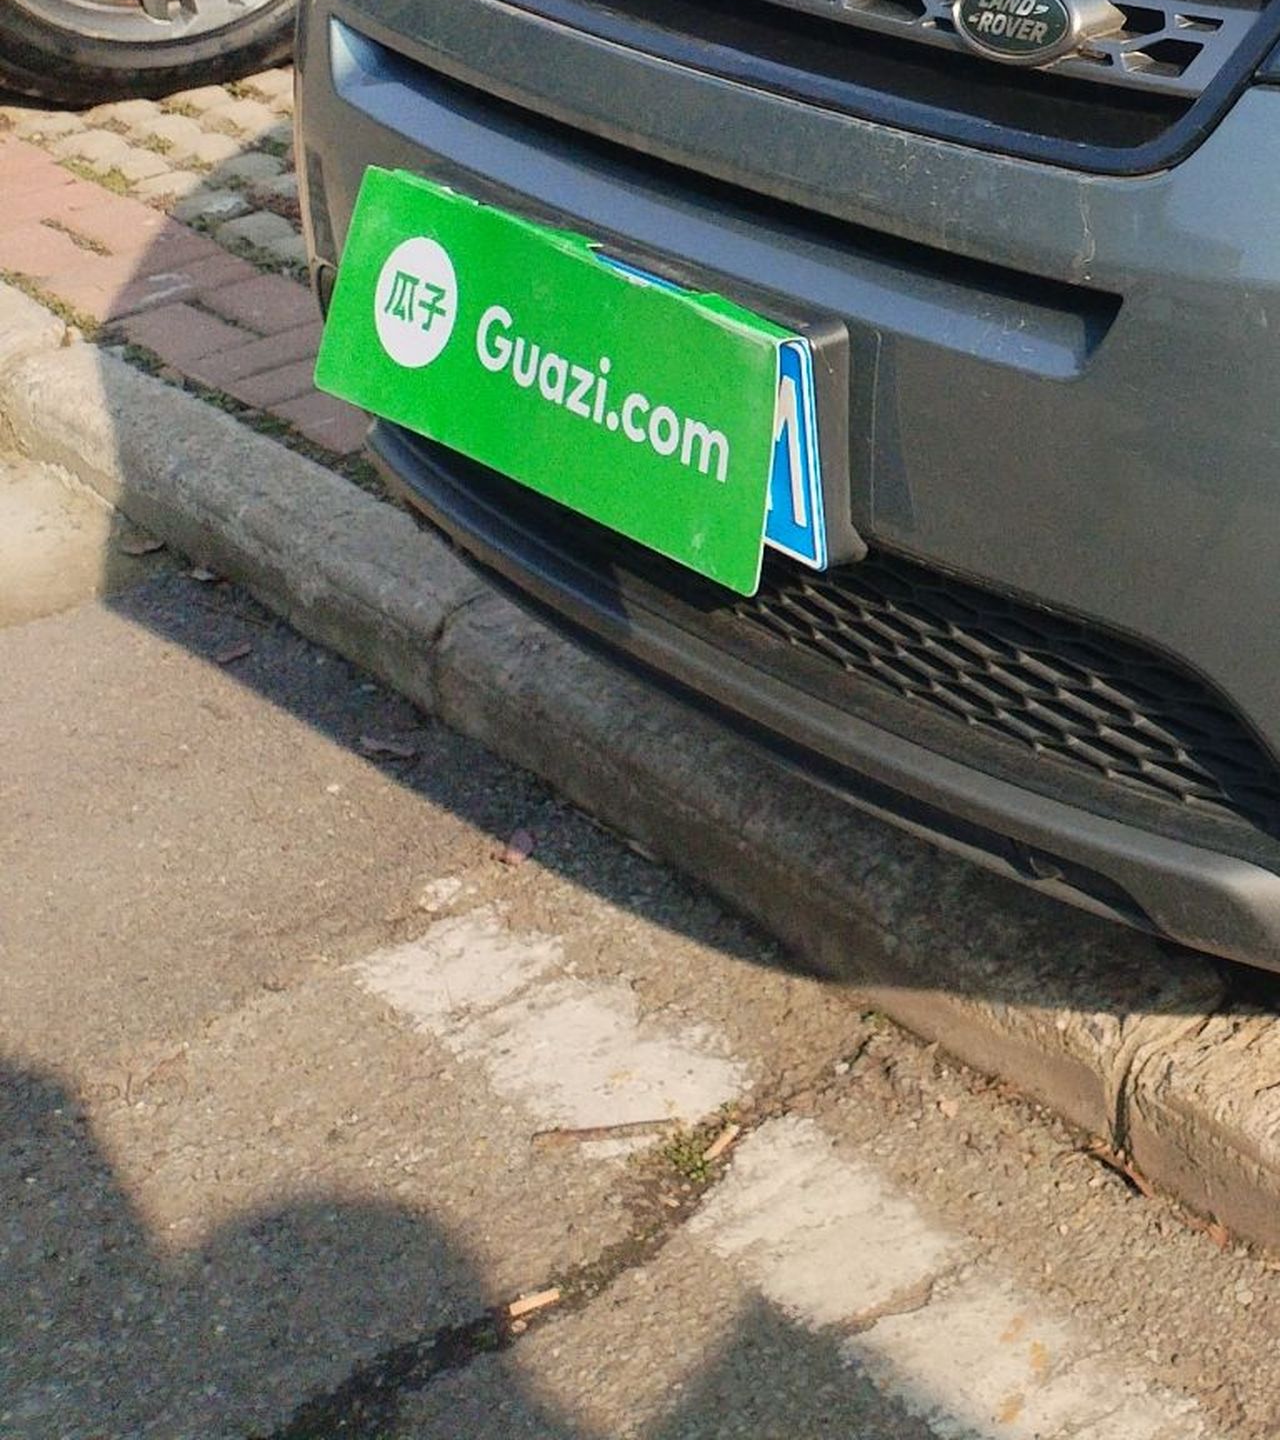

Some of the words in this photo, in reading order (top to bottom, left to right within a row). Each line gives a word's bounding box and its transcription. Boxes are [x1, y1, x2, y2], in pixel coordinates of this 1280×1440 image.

[976, 10, 1049, 44] ROVER
[383, 270, 447, 332] 瓜子
[475, 304, 731, 484] Guazi.com
